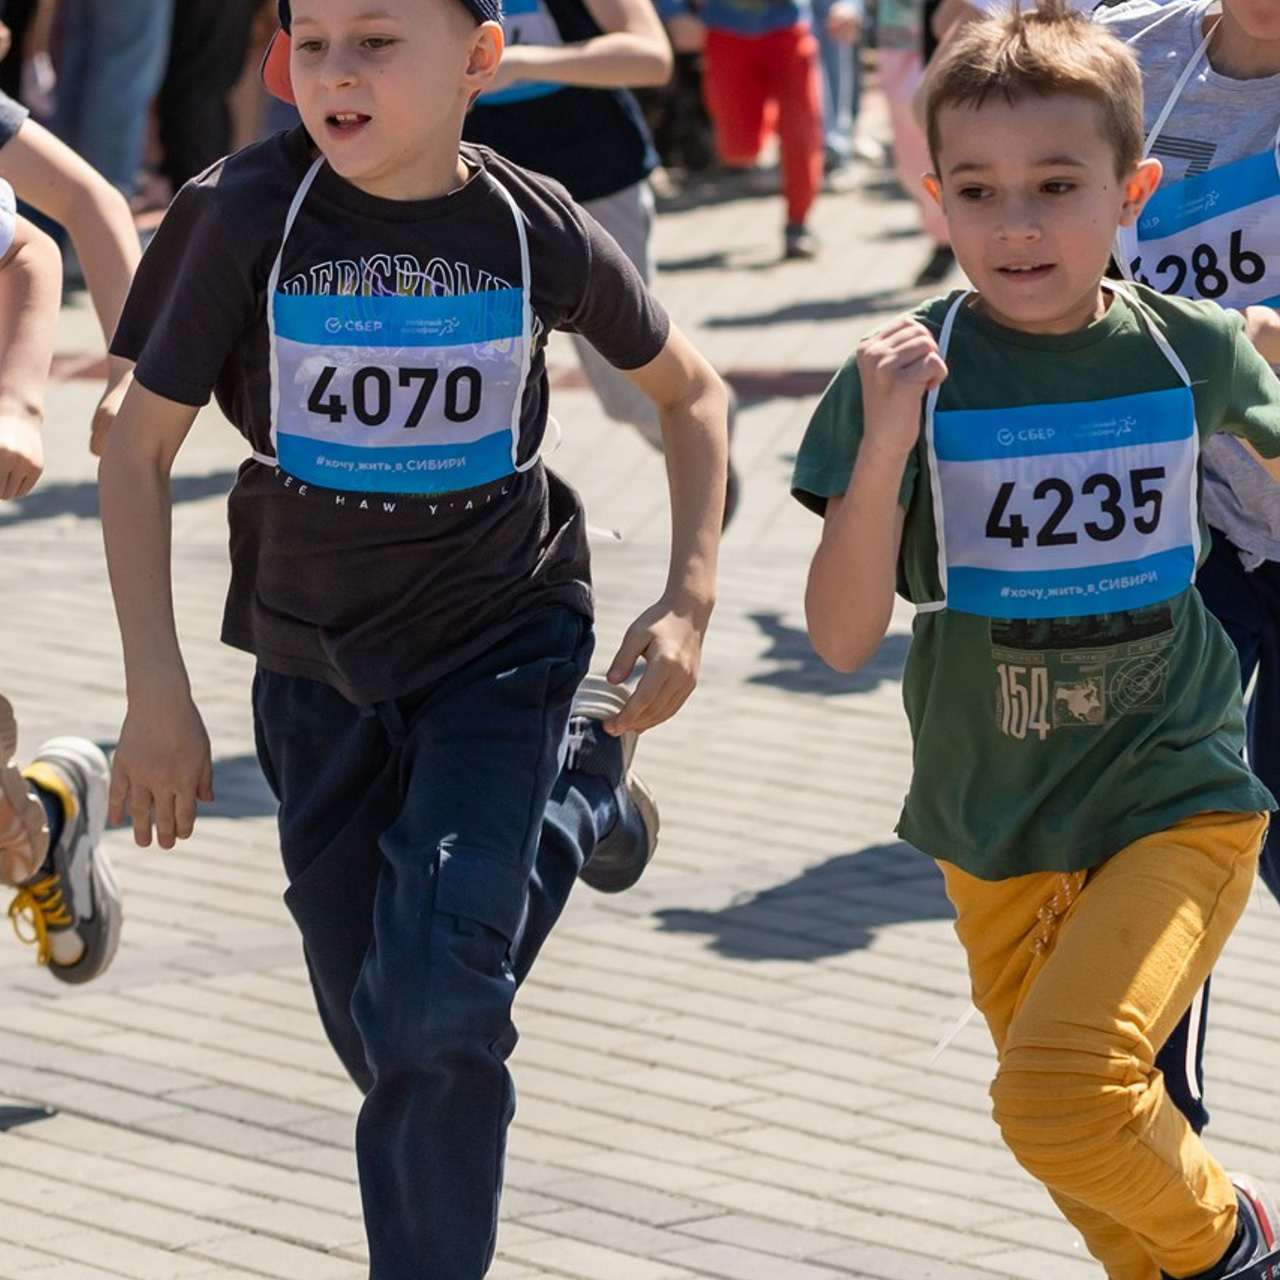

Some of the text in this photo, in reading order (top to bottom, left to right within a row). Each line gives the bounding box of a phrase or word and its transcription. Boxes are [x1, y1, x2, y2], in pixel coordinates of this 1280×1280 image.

[344, 320, 383, 333] СБЕР
[306, 366, 483, 428] 4070
[1018, 428, 1056, 441] СБЕР
[315, 454, 467, 472] #хочу_жить_в_СИБИРИ
[335, 495, 396, 514] HAW
[985, 466, 1167, 548] 4235
[1000, 570, 1158, 598] #хочу_жить_в_СИБИРИ
[996, 663, 1051, 740] 154
